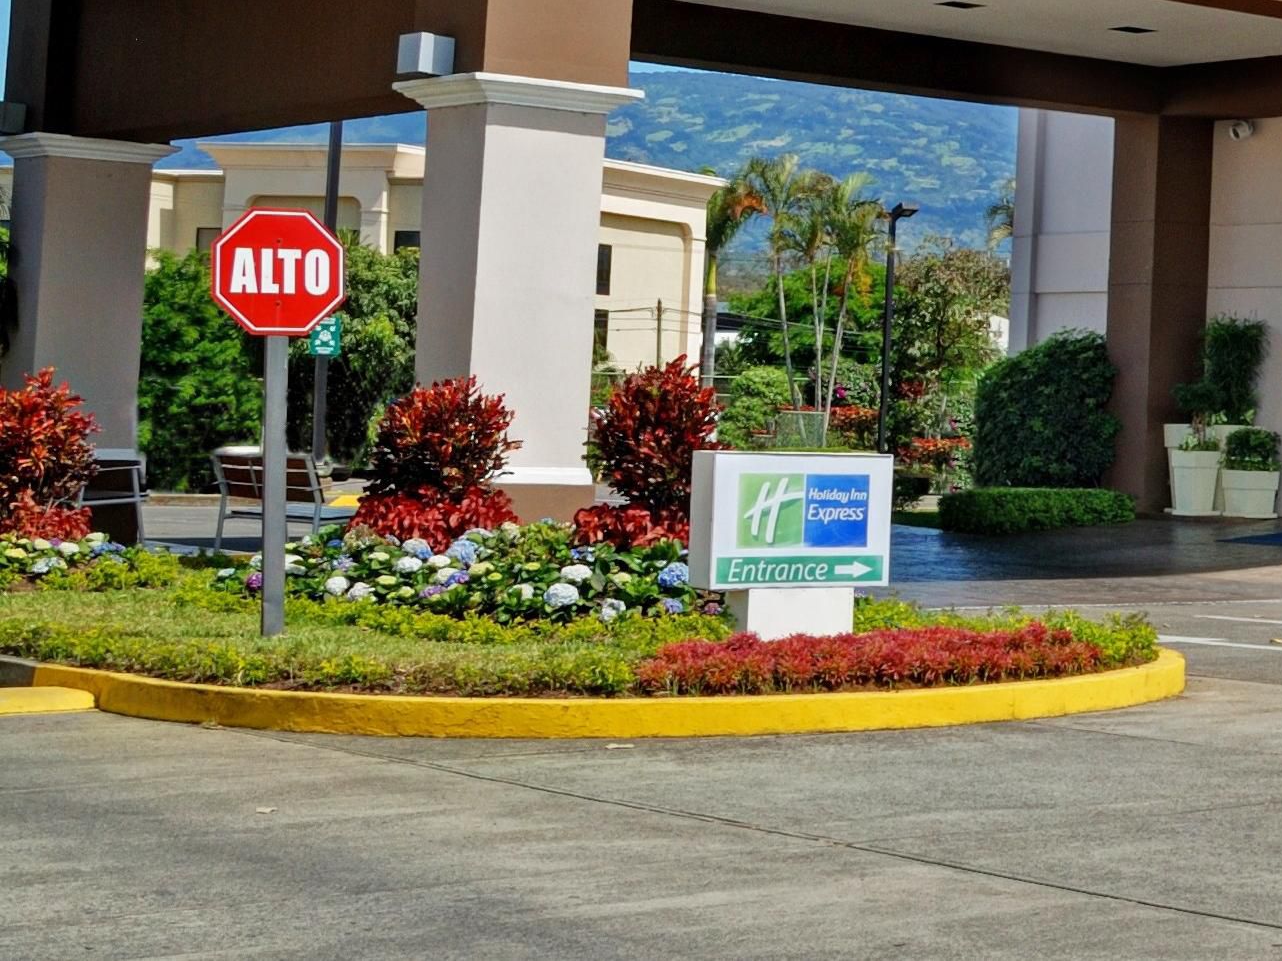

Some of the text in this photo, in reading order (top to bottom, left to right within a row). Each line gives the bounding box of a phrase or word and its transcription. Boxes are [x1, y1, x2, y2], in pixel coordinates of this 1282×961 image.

[229, 246, 332, 297] ALTO
[808, 487, 868, 504] Holiday Inn
[807, 505, 865, 526] Express
[727, 558, 830, 583] Entrance
